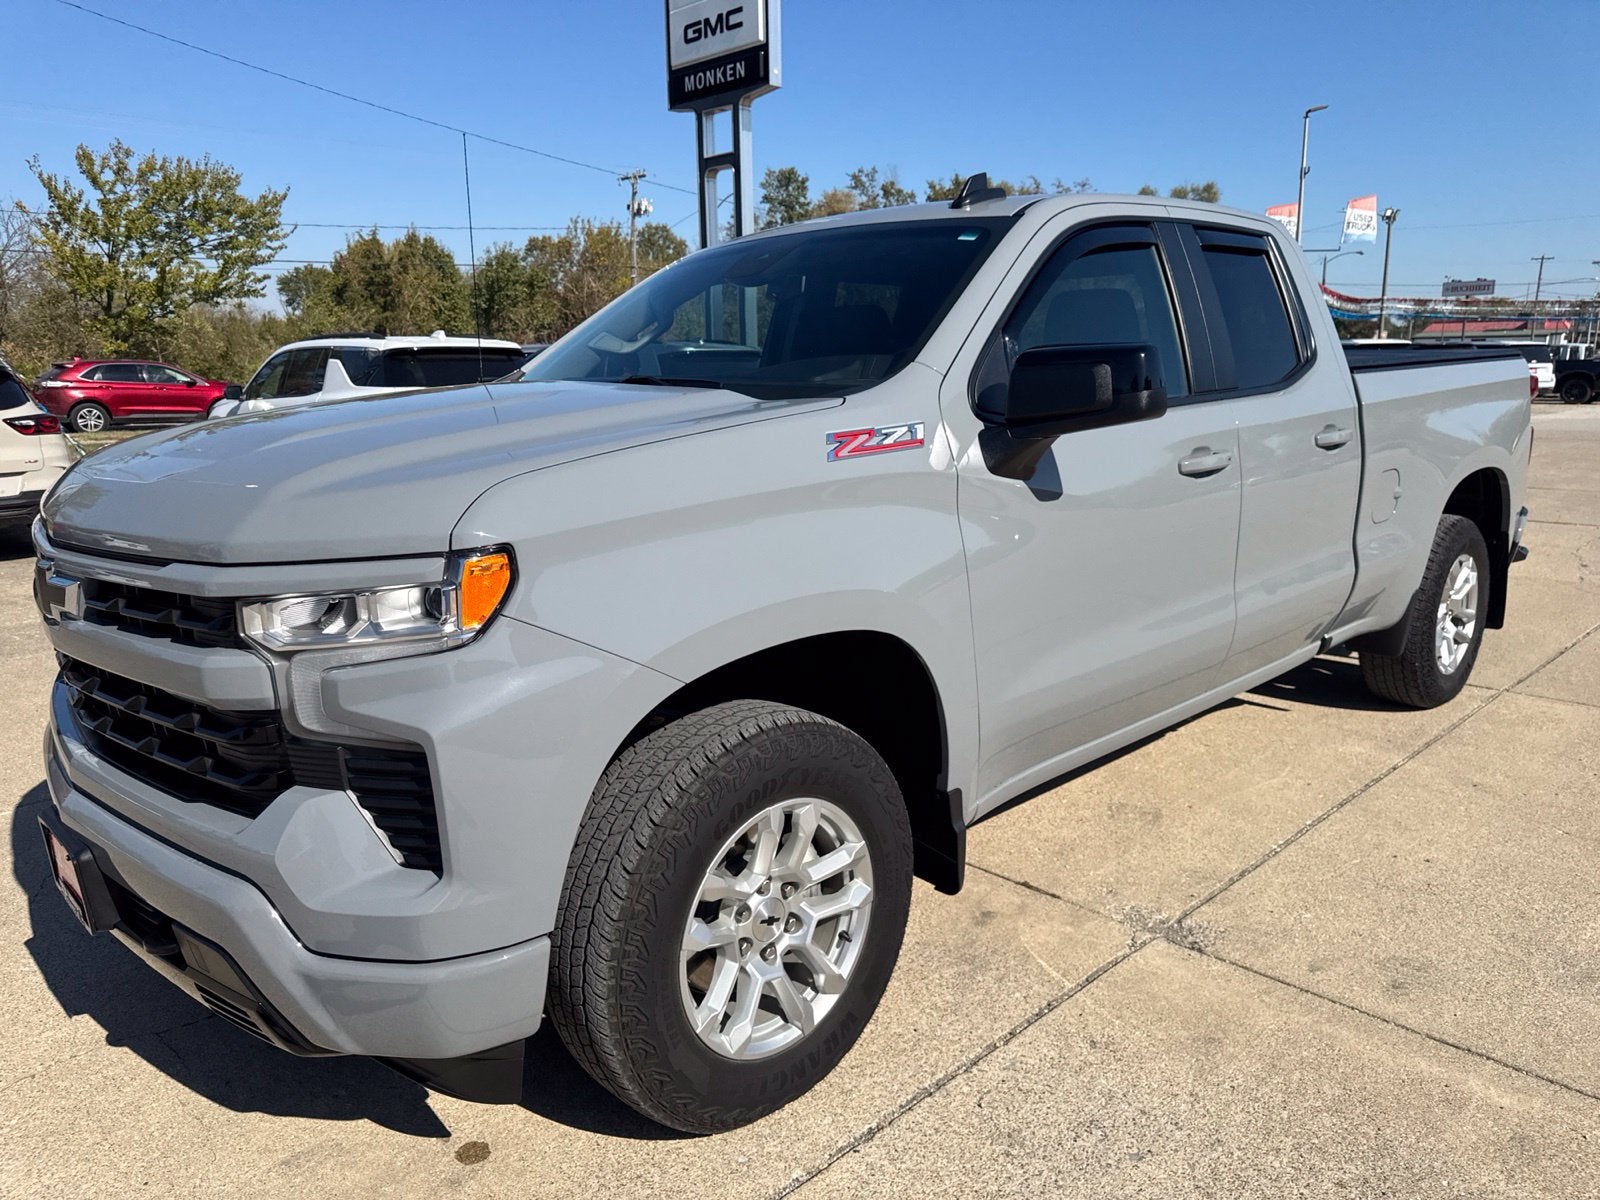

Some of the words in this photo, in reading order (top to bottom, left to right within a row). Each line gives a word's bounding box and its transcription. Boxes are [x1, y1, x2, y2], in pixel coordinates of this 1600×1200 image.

[683, 6, 744, 45] GMC
[684, 60, 746, 93] MONKEN
[826, 421, 925, 462] Z71
